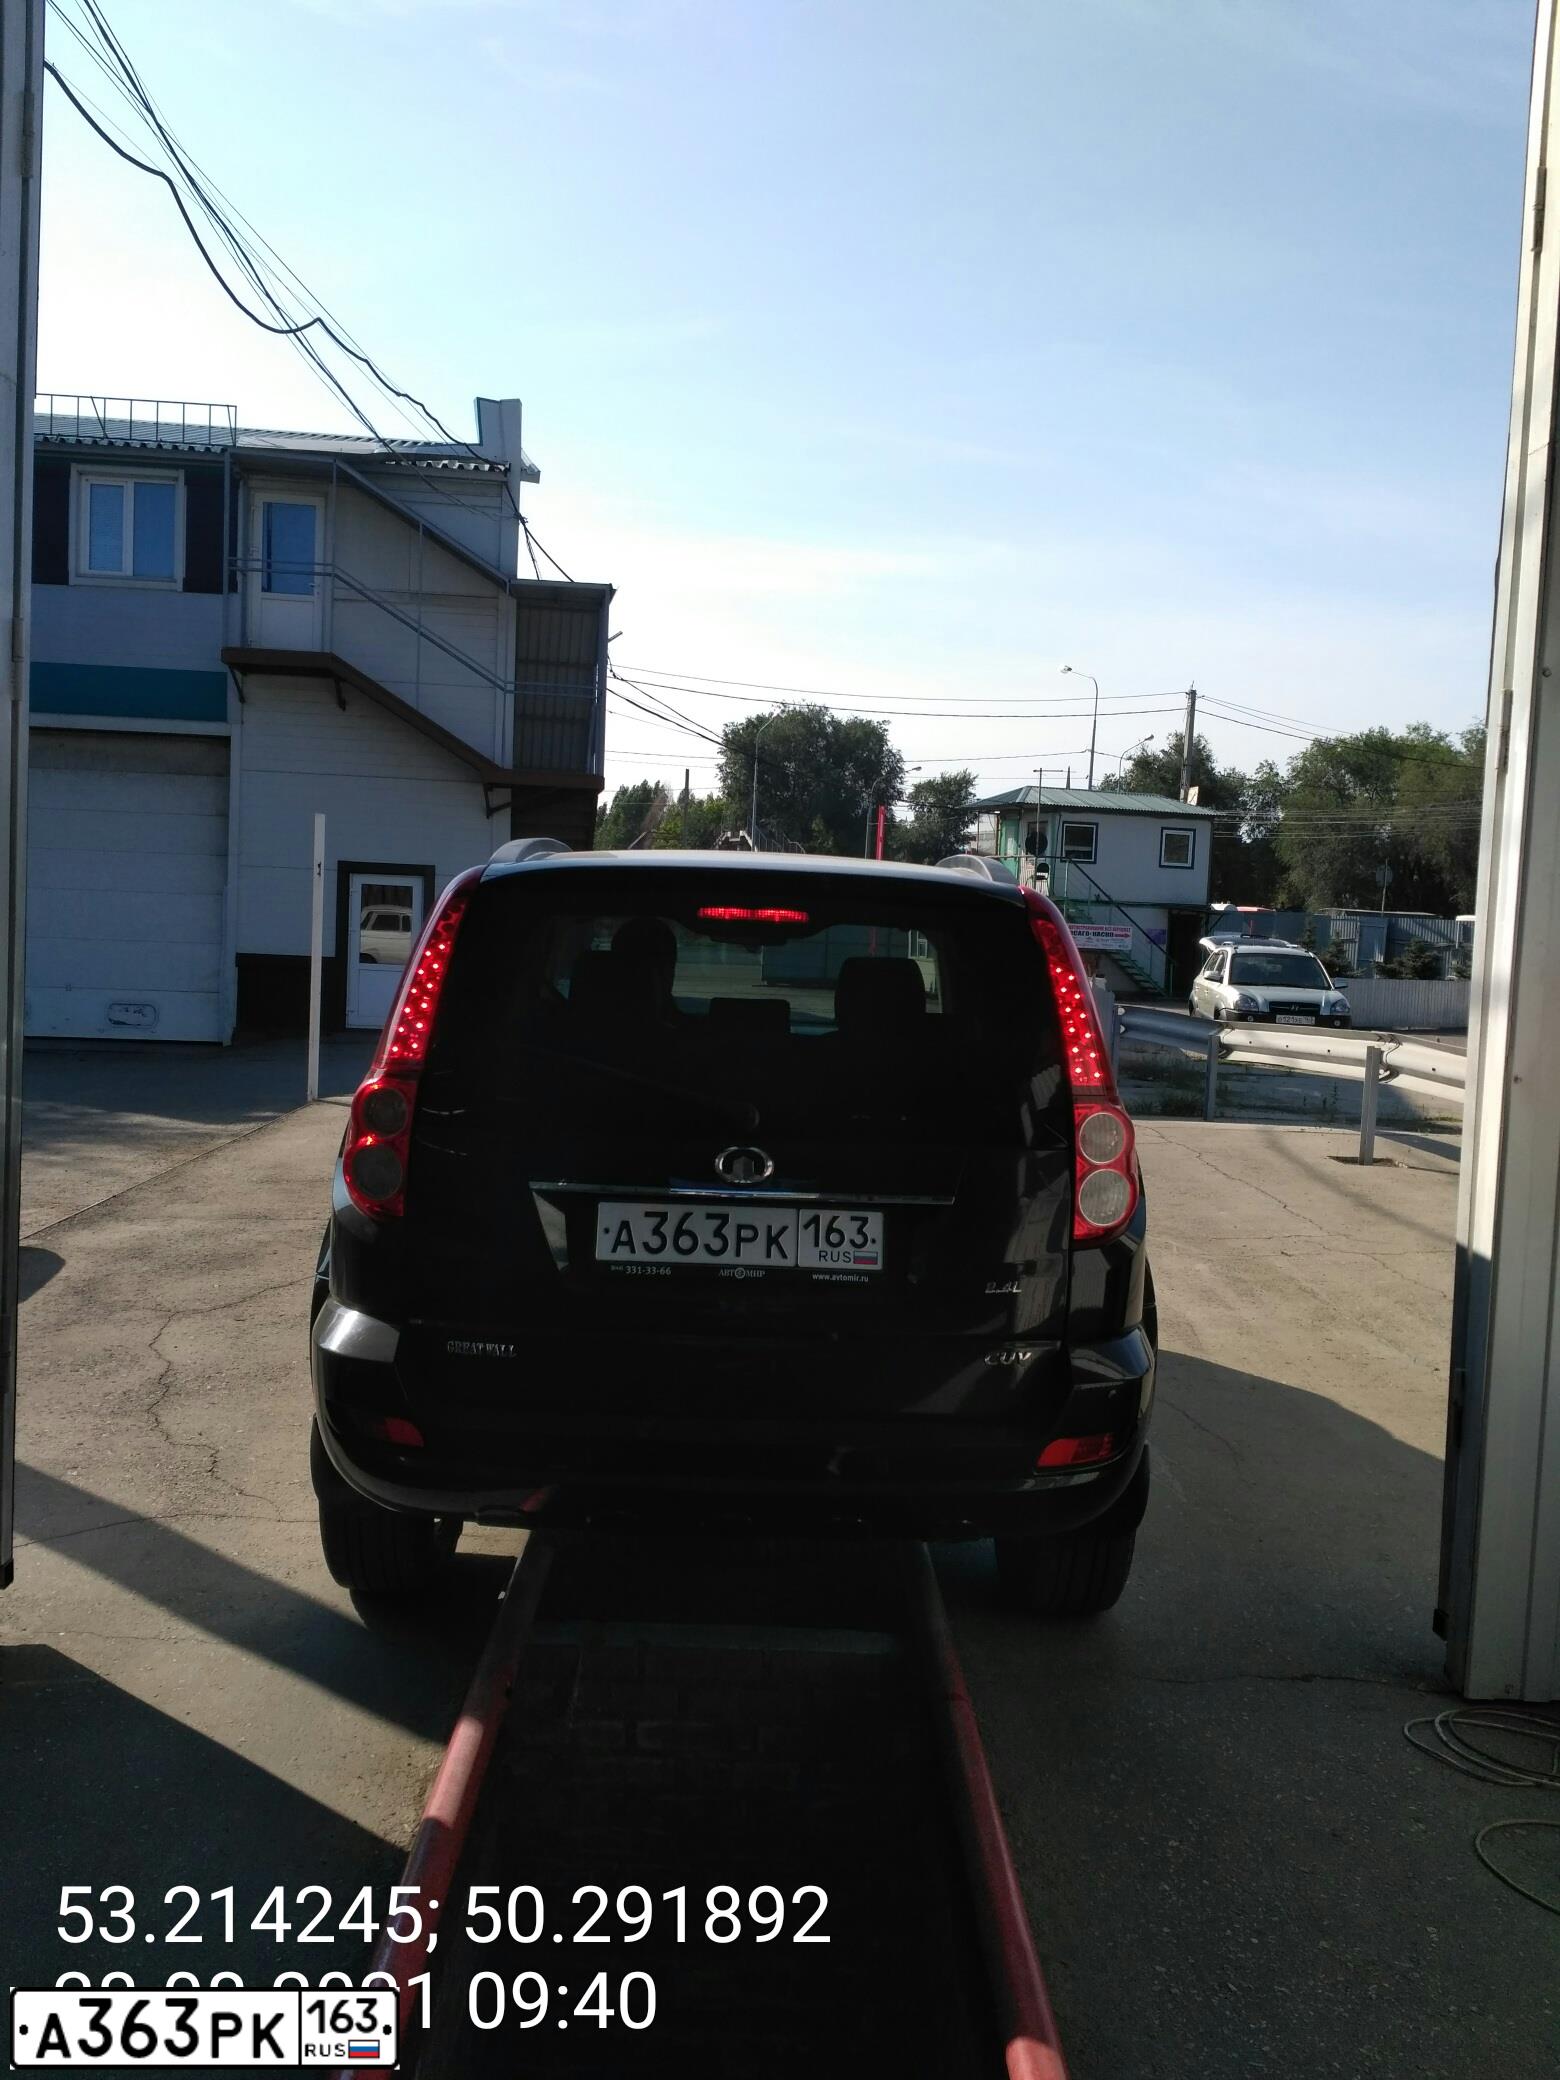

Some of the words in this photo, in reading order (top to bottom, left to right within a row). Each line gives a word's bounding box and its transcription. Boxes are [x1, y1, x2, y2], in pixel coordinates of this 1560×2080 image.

[611, 1211, 789, 1259] А363РК
[803, 1214, 869, 1250] 163
[818, 1251, 852, 1264] RUS
[625, 1265, 672, 1275] 331-33-66
[812, 1272, 869, 1283] www.avtomir.ru
